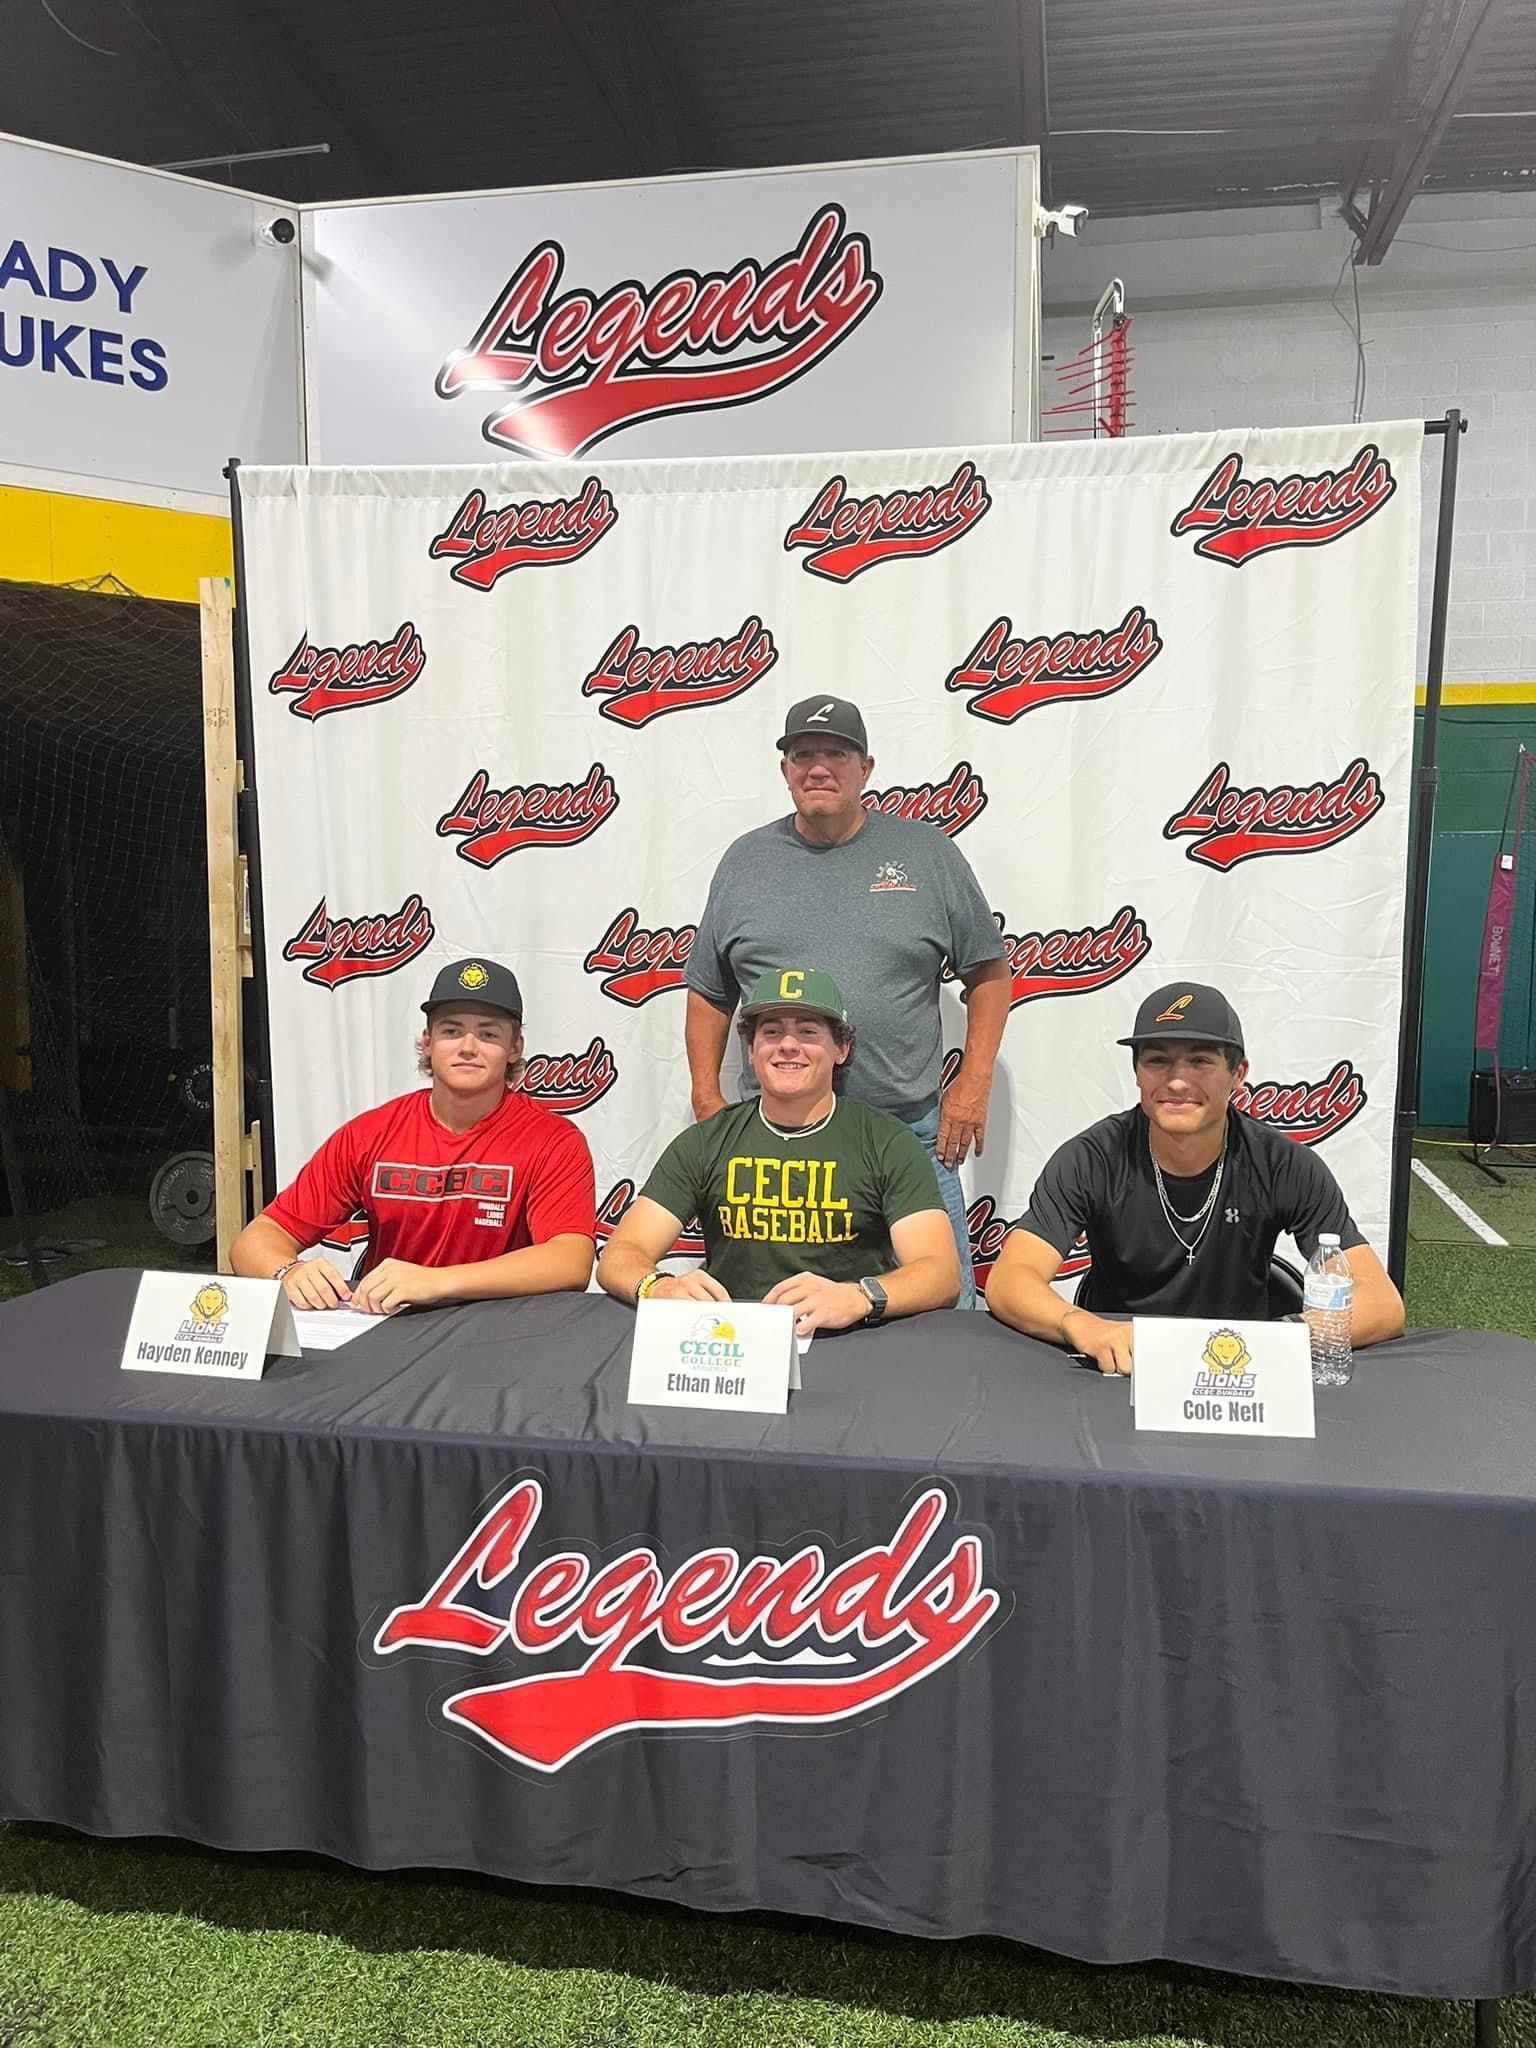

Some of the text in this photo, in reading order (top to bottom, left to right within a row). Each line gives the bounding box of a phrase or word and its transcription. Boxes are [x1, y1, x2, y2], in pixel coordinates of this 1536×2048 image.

[434, 202, 884, 460] Legends
[784, 461, 992, 583] Legends
[1171, 444, 1396, 567] Legends
[430, 476, 617, 591] Legends
[582, 615, 779, 729] Legends
[945, 606, 1164, 725] Legends
[806, 703, 835, 723] L
[436, 762, 620, 869] Legends
[1163, 758, 1386, 872] Legends
[583, 907, 698, 1008] Lege
[779, 970, 805, 999] C
[1002, 905, 1153, 1013] egends
[1155, 994, 1195, 1022] L
[511, 1036, 619, 1115] ends
[379, 1168, 505, 1194] CCBC
[726, 1156, 849, 1210] CECIL
[718, 1205, 860, 1243] BASEBALL
[136, 1341, 249, 1369] Hayden Kenney
[178, 1320, 230, 1336] LIONS
[680, 1340, 745, 1357] CECIL
[667, 1373, 746, 1395] Ethan Neff
[681, 1356, 742, 1367] COLLEGE
[1196, 1372, 1257, 1388] LIONS
[1183, 1400, 1265, 1423] Cole Neff
[374, 1479, 1000, 1772] Legends
